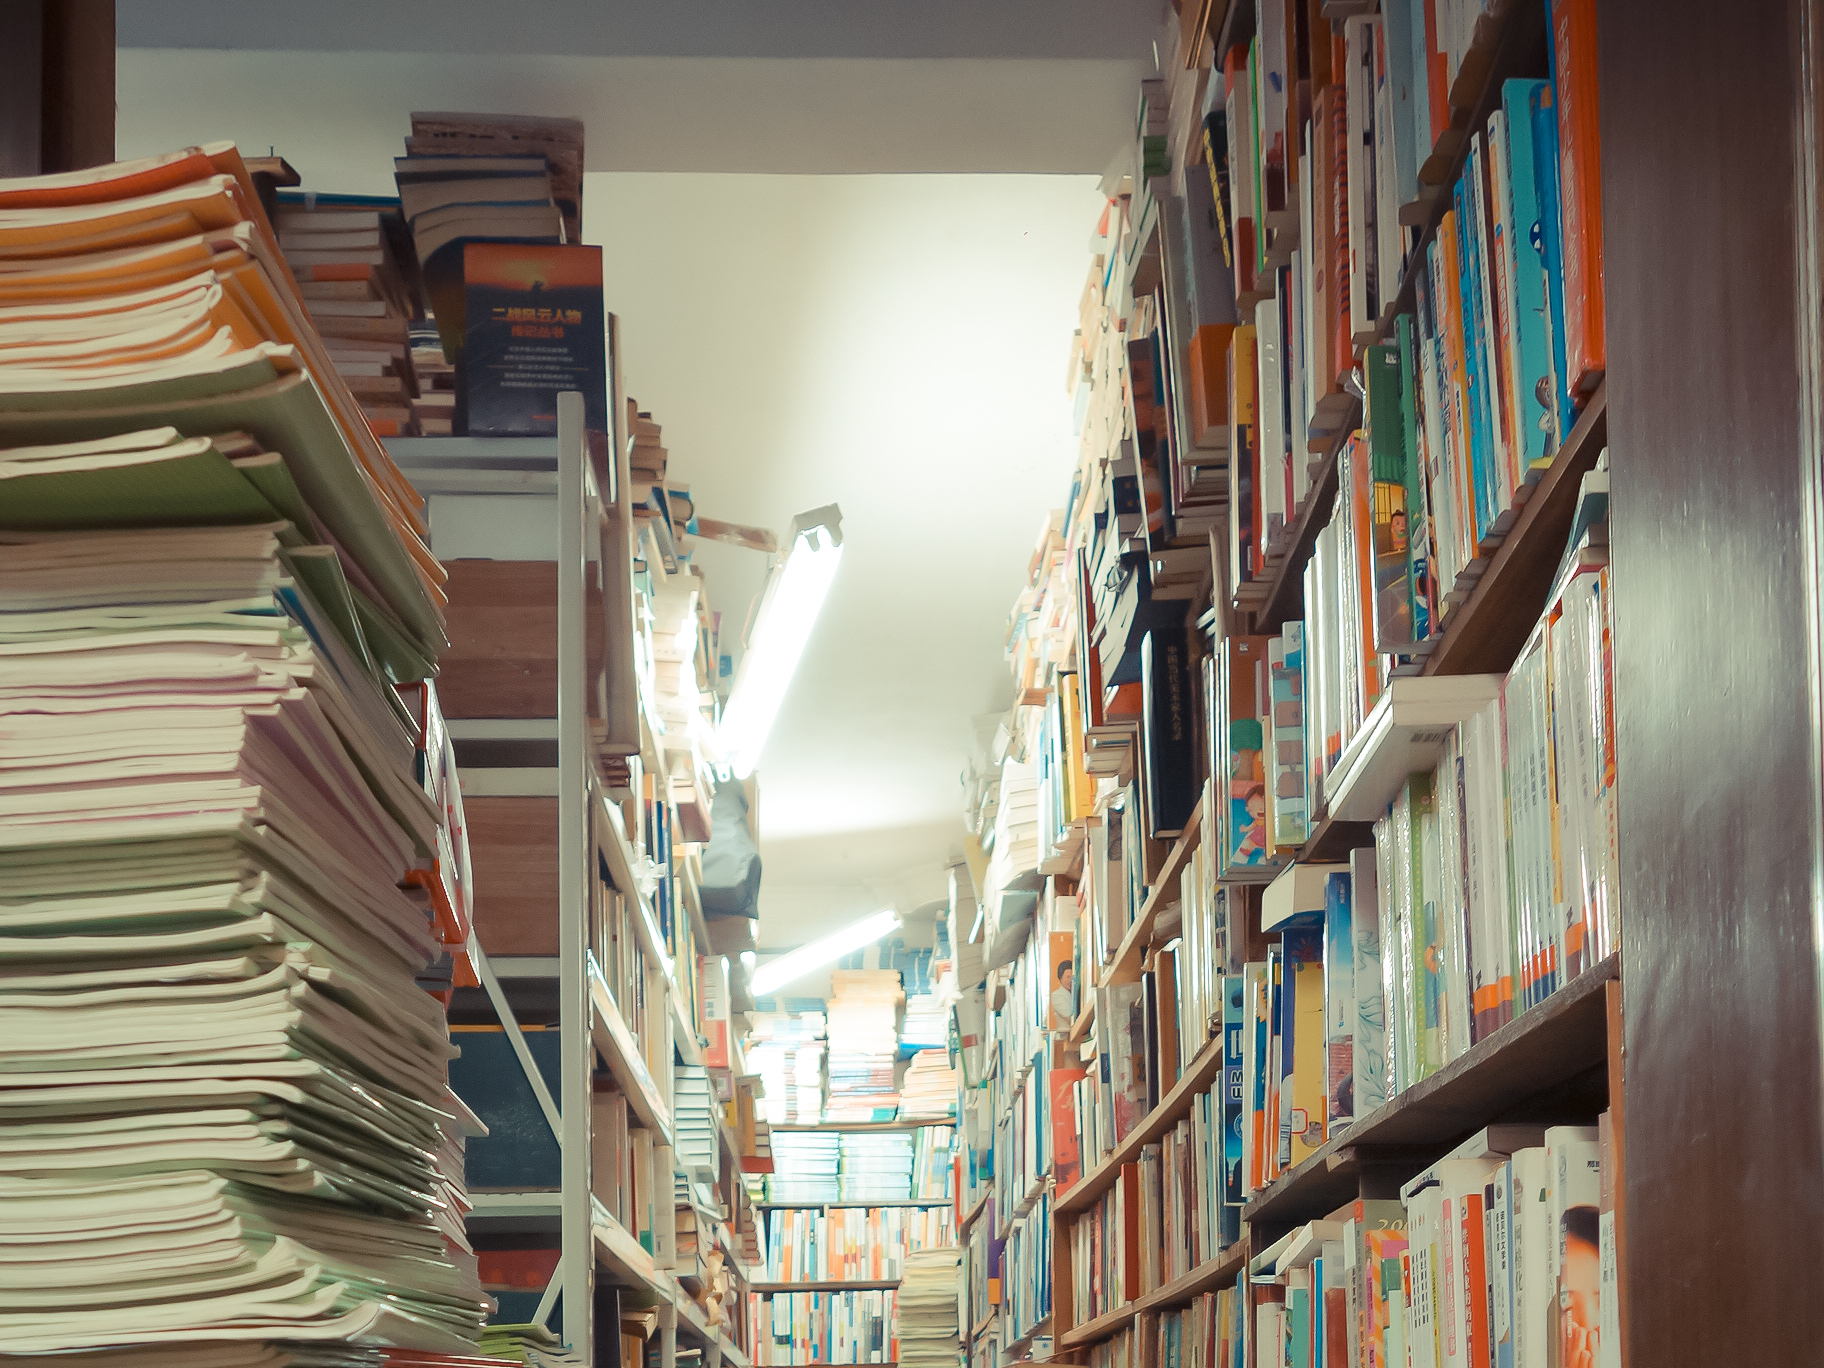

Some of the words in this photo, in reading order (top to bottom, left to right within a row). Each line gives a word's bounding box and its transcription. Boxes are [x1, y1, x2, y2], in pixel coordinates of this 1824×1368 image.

[491, 307, 582, 324] 二战风云人物
